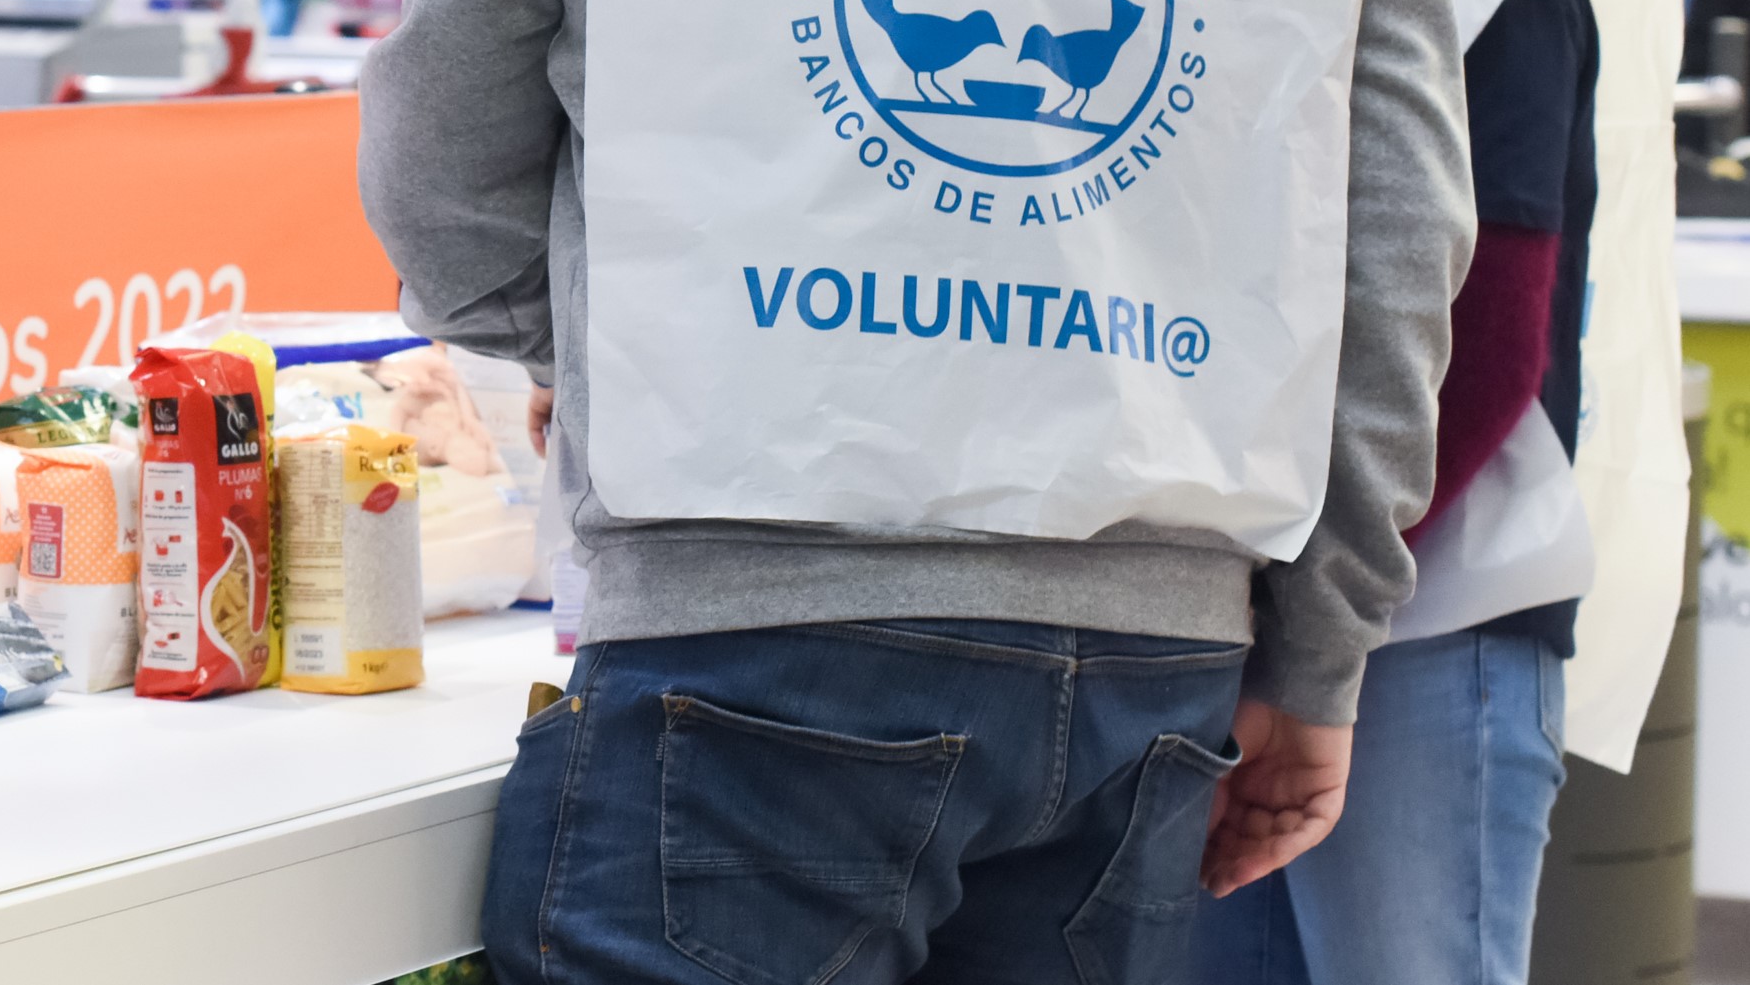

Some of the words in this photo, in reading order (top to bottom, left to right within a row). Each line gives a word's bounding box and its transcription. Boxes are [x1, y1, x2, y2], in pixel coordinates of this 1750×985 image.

[790, 16, 916, 191] BANCOS
[933, 180, 996, 225] DE
[1019, 50, 1207, 226] ALIMENTOS
[742, 266, 1210, 378] VOLUNTARI@
[219, 467, 262, 485] PLUMAS
[221, 442, 258, 458] GALLO
